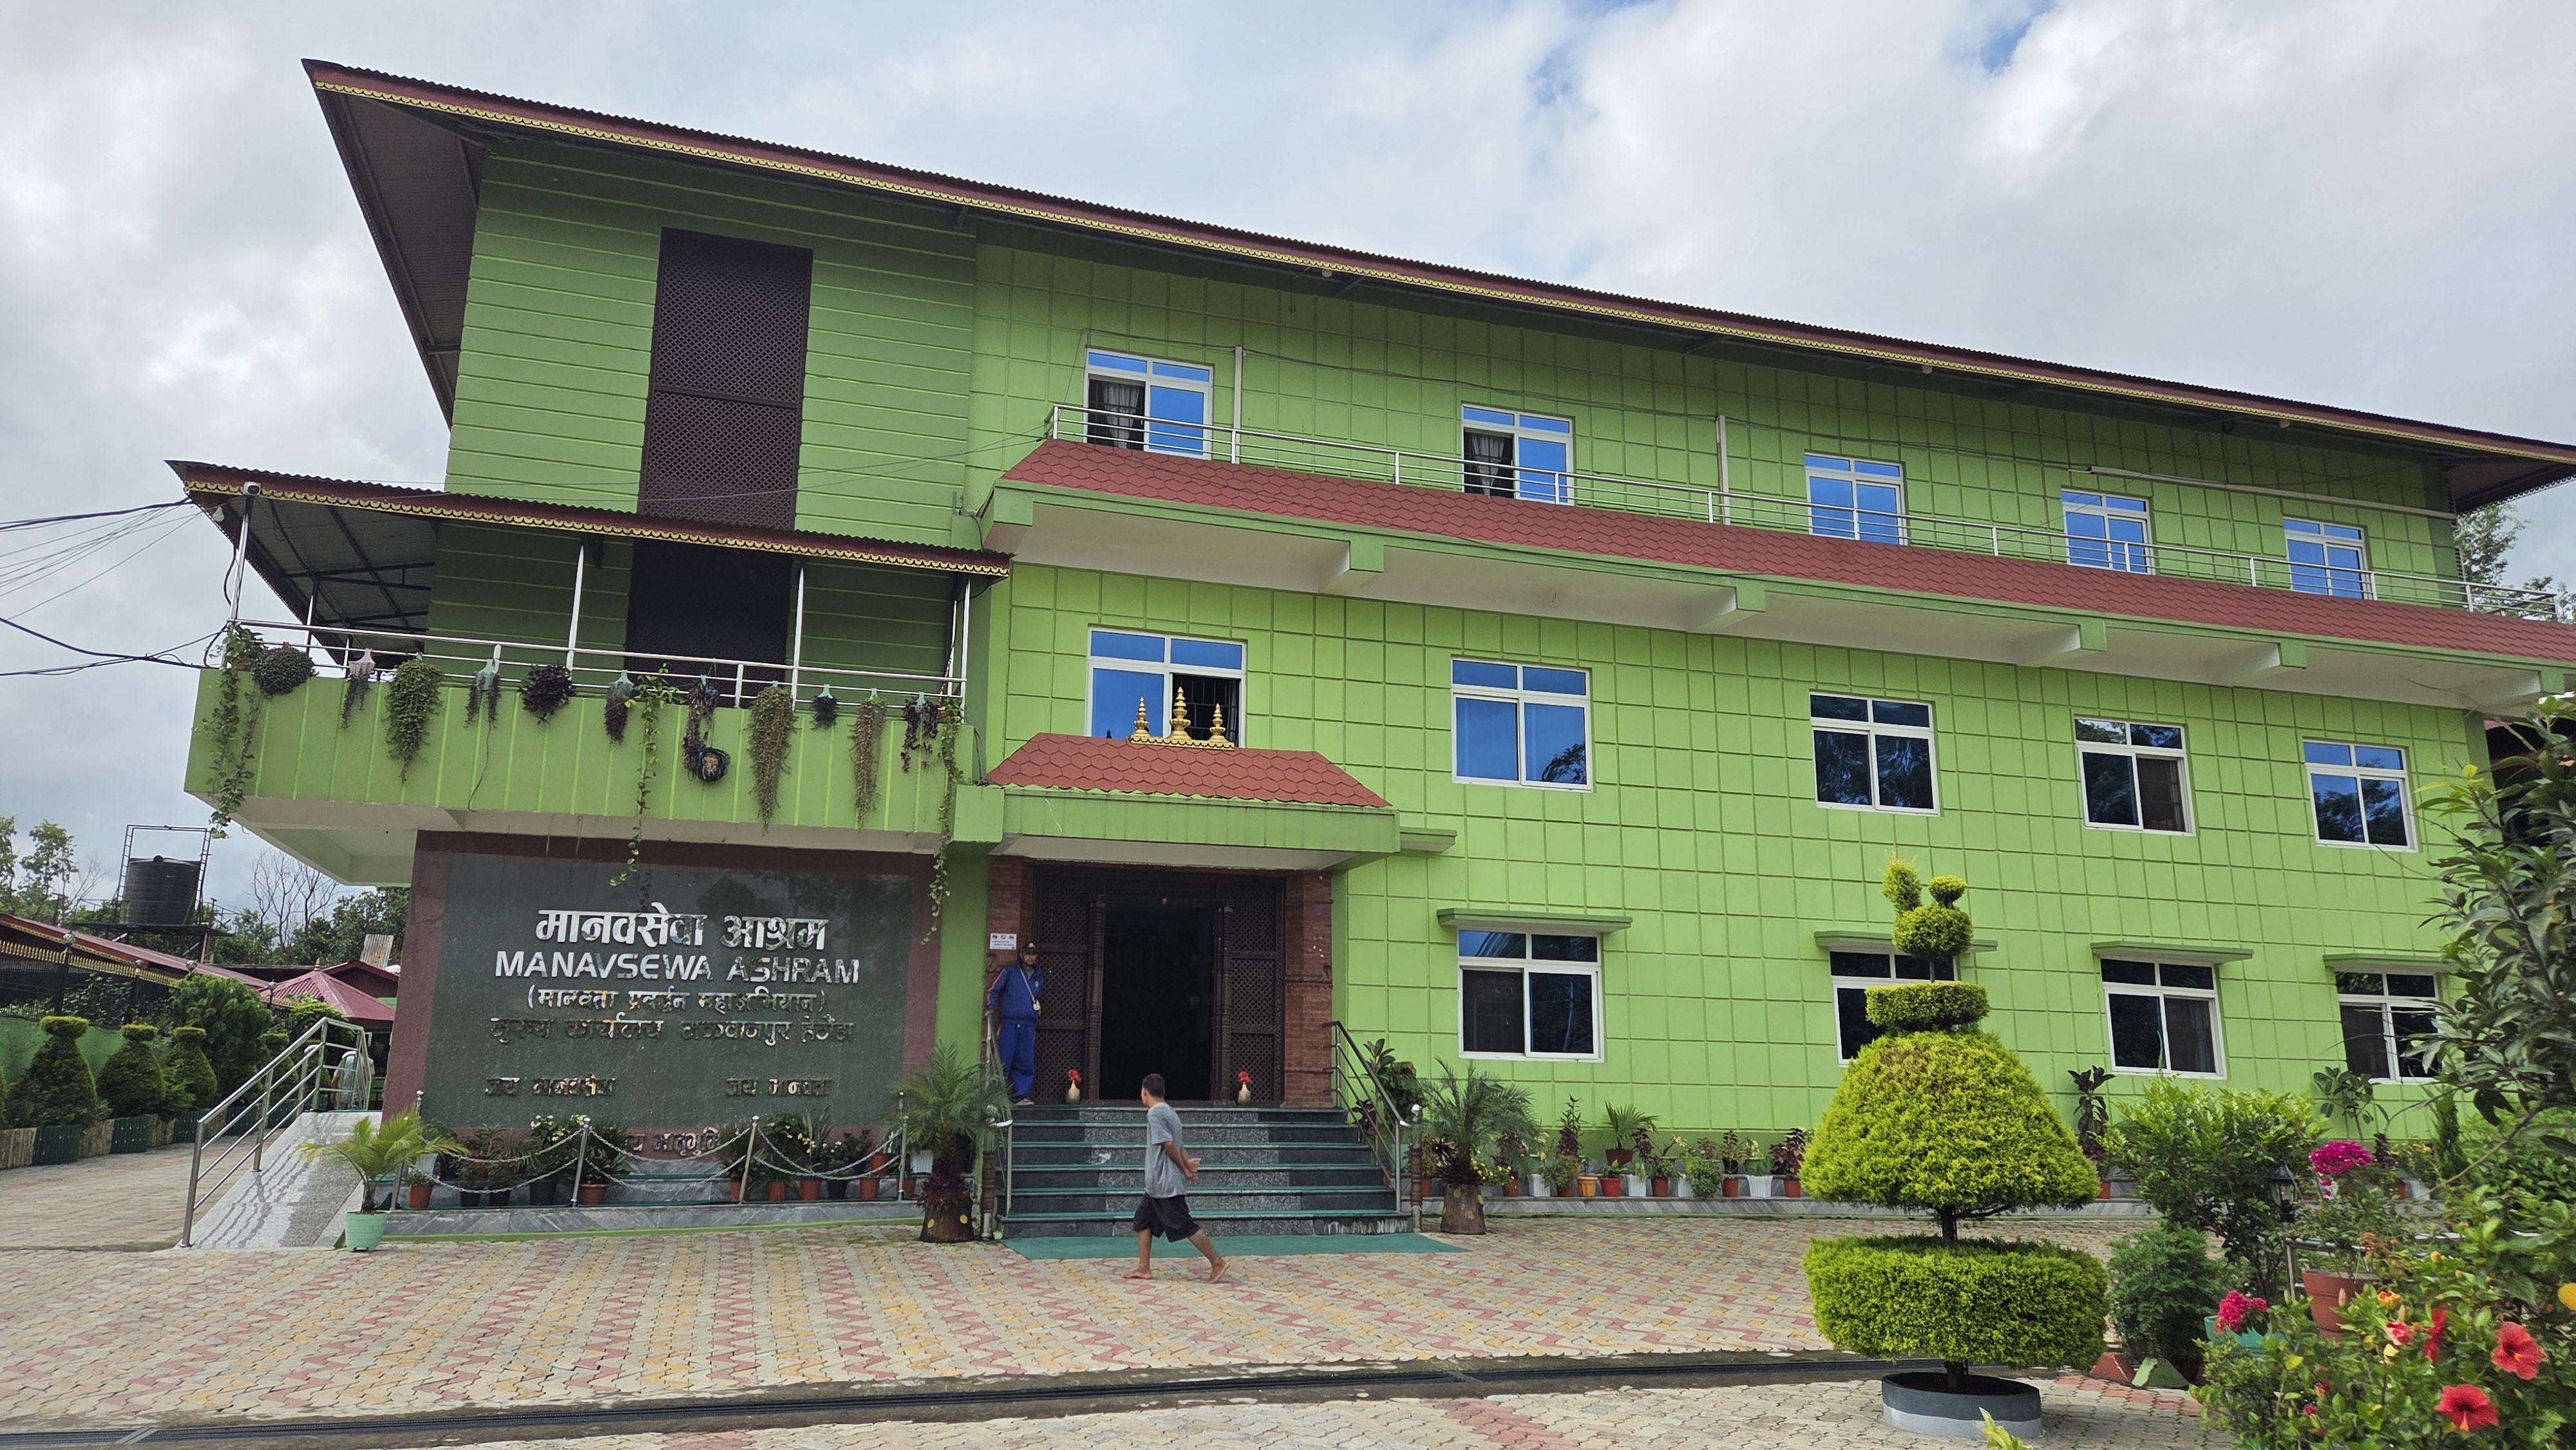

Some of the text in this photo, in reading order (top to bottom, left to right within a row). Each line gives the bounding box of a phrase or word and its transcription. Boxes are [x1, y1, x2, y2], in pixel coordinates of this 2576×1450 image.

[535, 902, 829, 951] मानवसेवा आश्रम
[495, 951, 860, 984] MANAVSEWA ASHRAM
[527, 984, 620, 1010] (मानवता
